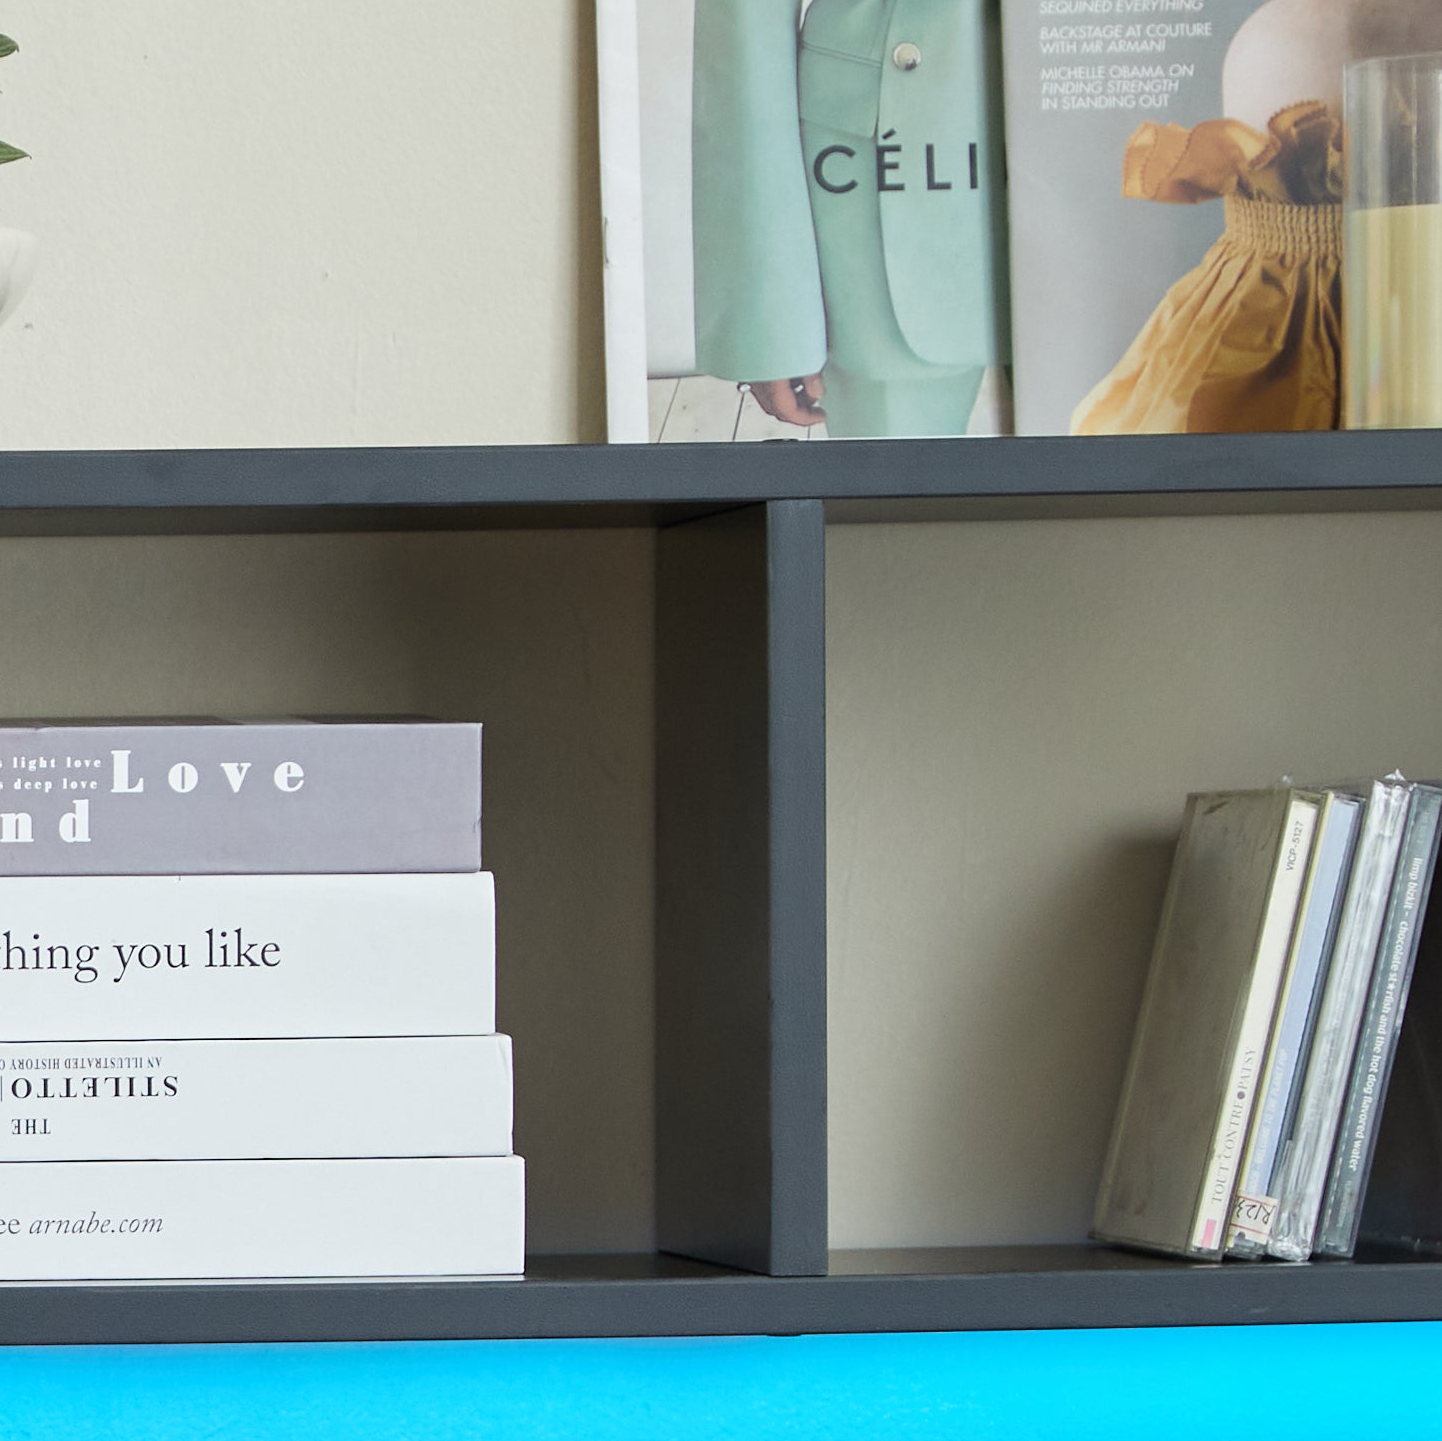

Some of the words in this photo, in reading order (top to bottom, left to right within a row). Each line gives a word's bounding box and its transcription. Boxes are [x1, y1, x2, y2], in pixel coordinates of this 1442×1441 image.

[1040, 0, 1112, 14] SEQUINED
[1040, 25, 1122, 40] BACKSTAGE
[1126, 25, 1141, 38] AT
[1146, 23, 1212, 37] COUTURE
[1040, 41, 1076, 54] WITH
[1081, 41, 1102, 53] MR
[1108, 39, 1166, 52] ARMANI
[1042, 66, 1104, 80] MICHELLE
[1109, 65, 1164, 78] OBAMA
[1169, 64, 1194, 76] ON
[1042, 81, 1102, 94] FINDING
[1107, 79, 1179, 93] STRENGTH
[1042, 97, 1057, 110] IN
[1062, 95, 1135, 109] STANDING
[1140, 94, 1169, 107] OUT
[12, 757, 56, 772] light
[66, 757, 102, 768] love
[110, 748, 307, 795] Love
[14, 779, 53, 792] deep
[63, 779, 98, 790] love
[1285, 820, 1304, 872] VICP-5127
[1406, 858, 1423, 880] limp
[1403, 882, 1419, 910] bizkit
[112, 938, 189, 983] you
[205, 926, 282, 972] like
[1389, 921, 1410, 970] chocolate
[1377, 1015, 1391, 1034] and
[1373, 1035, 1388, 1053] the
[10, 1058, 60, 1070] HISTORY
[64, 1057, 142, 1069] ILLUSTRATED
[147, 1057, 162, 1068] AN
[1369, 1054, 1382, 1073] hot
[10, 1076, 178, 1099] STILETTO
[1362, 1074, 1378, 1095] dog
[10, 1118, 51, 1135] THE
[1355, 1096, 1374, 1138] flavored
[1348, 1139, 1365, 1172] water
[1211, 1164, 1231, 1206] TOUT
[29, 1211, 163, 1235] arnabe.com
